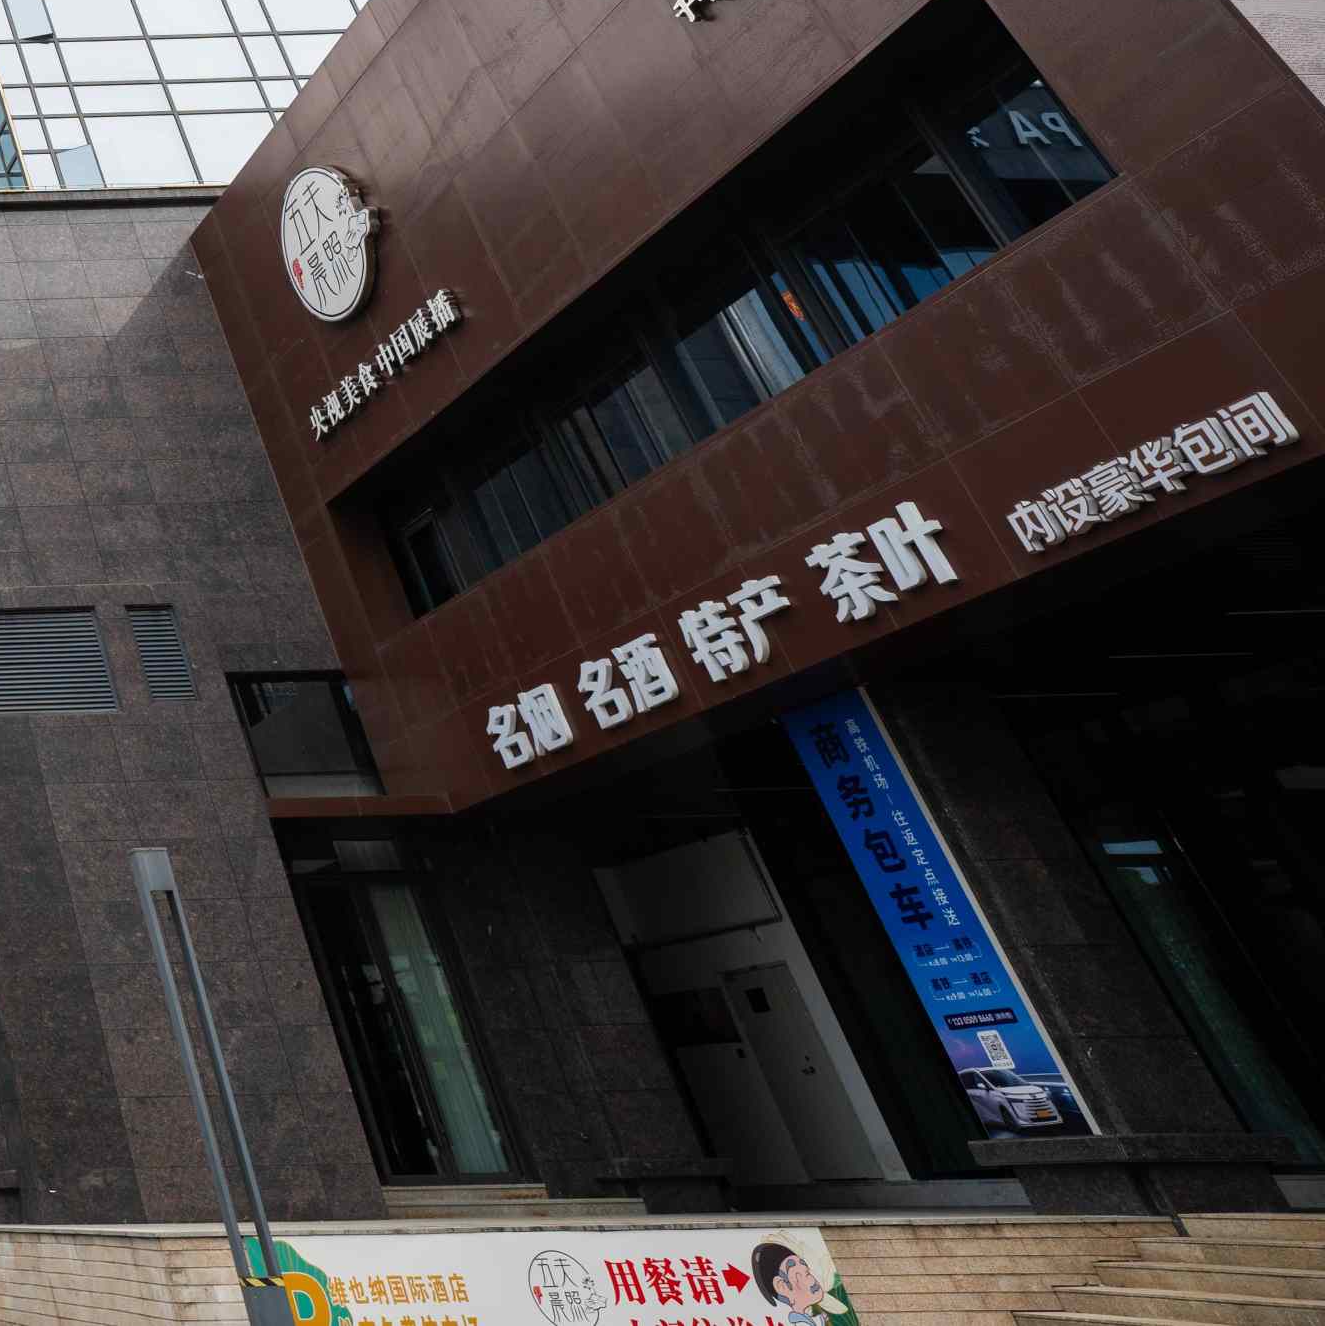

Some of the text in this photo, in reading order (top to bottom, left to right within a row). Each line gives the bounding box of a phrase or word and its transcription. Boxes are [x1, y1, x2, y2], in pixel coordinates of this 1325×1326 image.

[309, 288, 456, 442] 央视美食 中国展播
[1006, 391, 1301, 555] 内设豪华包间
[486, 500, 961, 770] 名烟 名酒 特产 茶叶
[807, 721, 934, 931] 商务包车
[328, 1272, 470, 1306] 维也纳国际酒店
[604, 1255, 725, 1306] 用餐请
